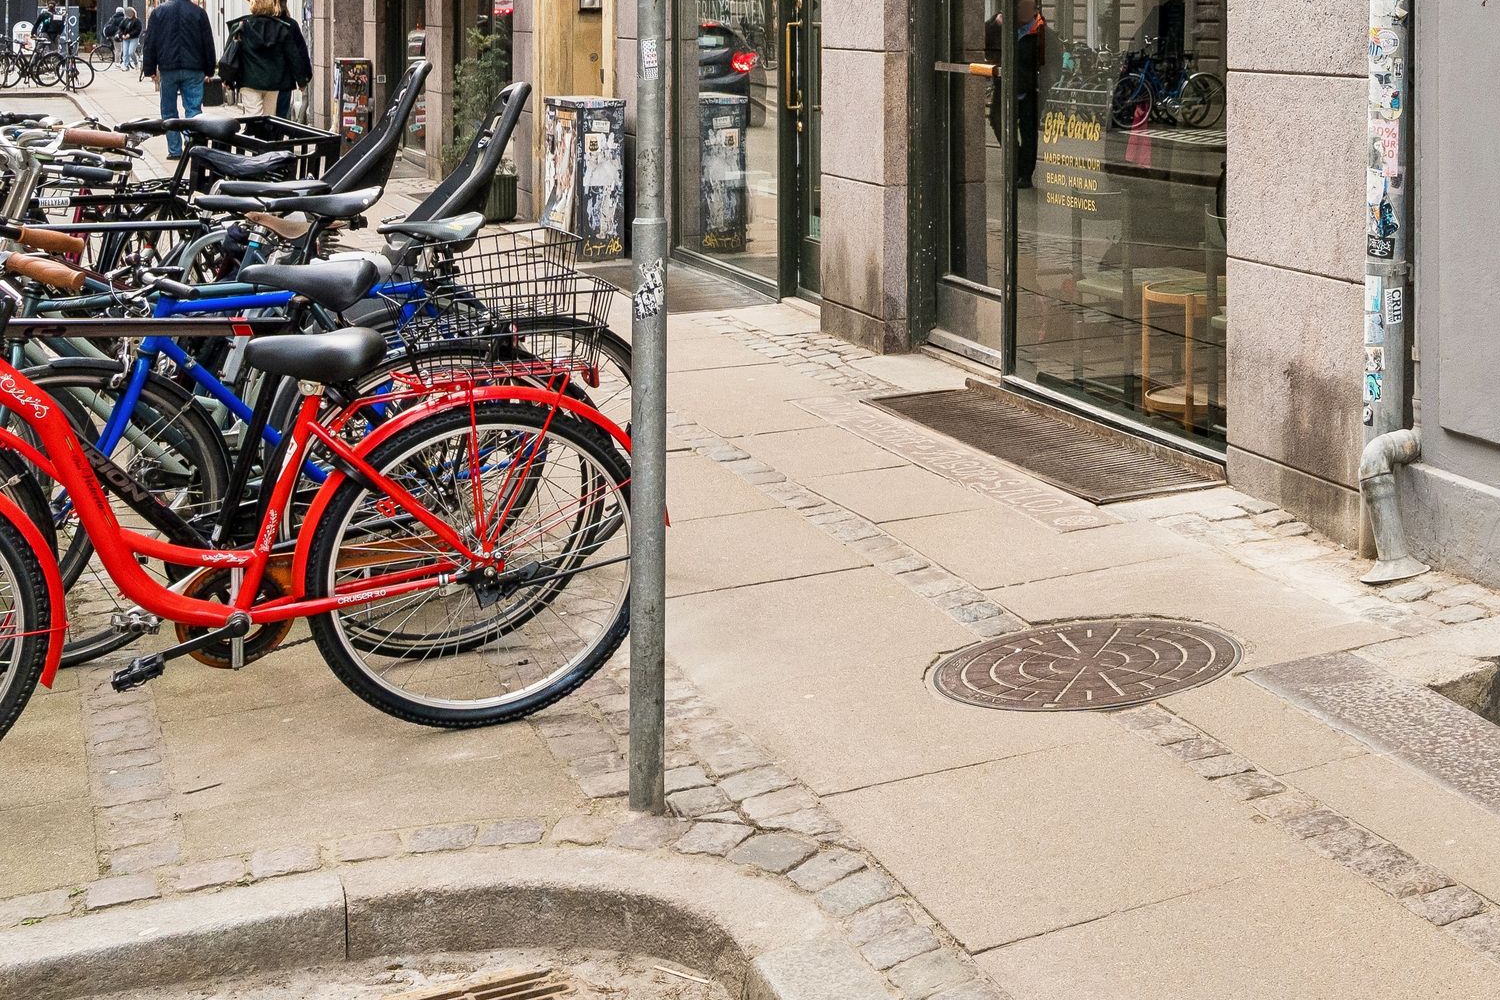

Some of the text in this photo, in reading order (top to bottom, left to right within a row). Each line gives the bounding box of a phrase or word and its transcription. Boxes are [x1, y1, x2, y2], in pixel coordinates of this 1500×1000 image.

[1043, 111, 1101, 144] Gift Cards
[1043, 152, 1101, 170] MADE FOR ALL OUR
[1046, 172, 1098, 191] BEARD, HAIR AND
[1046, 192, 1098, 212] SHAVE SERVICES.
